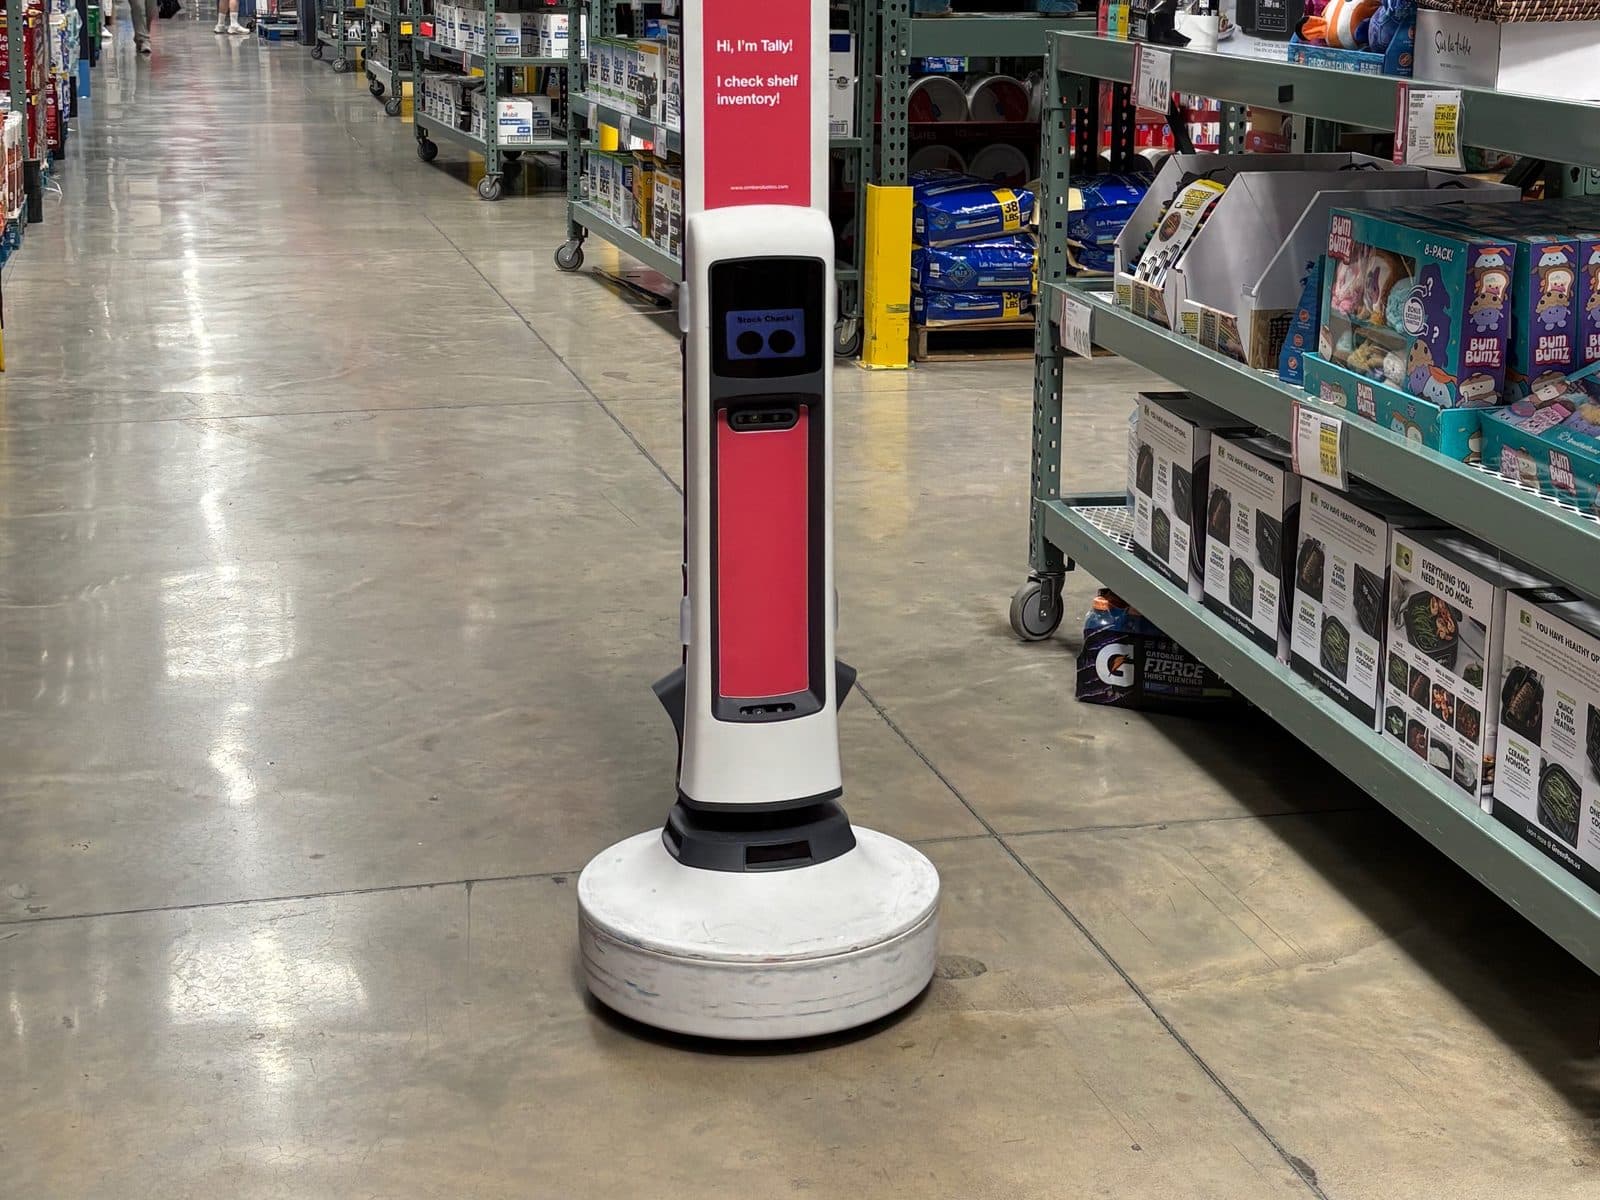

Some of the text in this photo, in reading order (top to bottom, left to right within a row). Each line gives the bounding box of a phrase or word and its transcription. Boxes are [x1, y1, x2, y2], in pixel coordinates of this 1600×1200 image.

[716, 39, 793, 54] Hi, I'm Tally!
[716, 74, 798, 87] I check shelf
[716, 92, 780, 107] inventory!
[1005, 200, 1018, 213] 38
[1005, 213, 1020, 222] LBS
[1332, 216, 1351, 236] BUM
[1329, 234, 1352, 256] BUMZ
[1424, 244, 1454, 261] 8-PACK!
[1005, 300, 1019, 309] LBS
[1470, 337, 1497, 350] BUM
[1540, 335, 1567, 349] BUM
[1465, 350, 1500, 363] BUMZ
[1536, 347, 1570, 361] BUMZ
[1550, 449, 1570, 472] BUM
[1549, 464, 1576, 489] BUMZ
[1320, 500, 1376, 537] YOU HAVE HEALTHY OPTIONS.
[1422, 559, 1470, 594] EVERYTHING YOU
[1421, 570, 1474, 610] NEED TO DO MORE.
[1536, 620, 1548, 635] YOU
[1549, 627, 1564, 644] HAVE
[1565, 637, 1590, 659] HEALTHY
[1146, 650, 1184, 661] GATORADE
[1096, 643, 1134, 687] G
[1144, 658, 1205, 679] FIERCE
[1144, 671, 1166, 682] THIRST
[1557, 700, 1574, 717] QUICK
[1553, 716, 1576, 736] HEATING
[1560, 711, 1574, 725] EVEN
[1505, 754, 1531, 777] NONSTICK
[1508, 747, 1530, 767] CERAMIC
